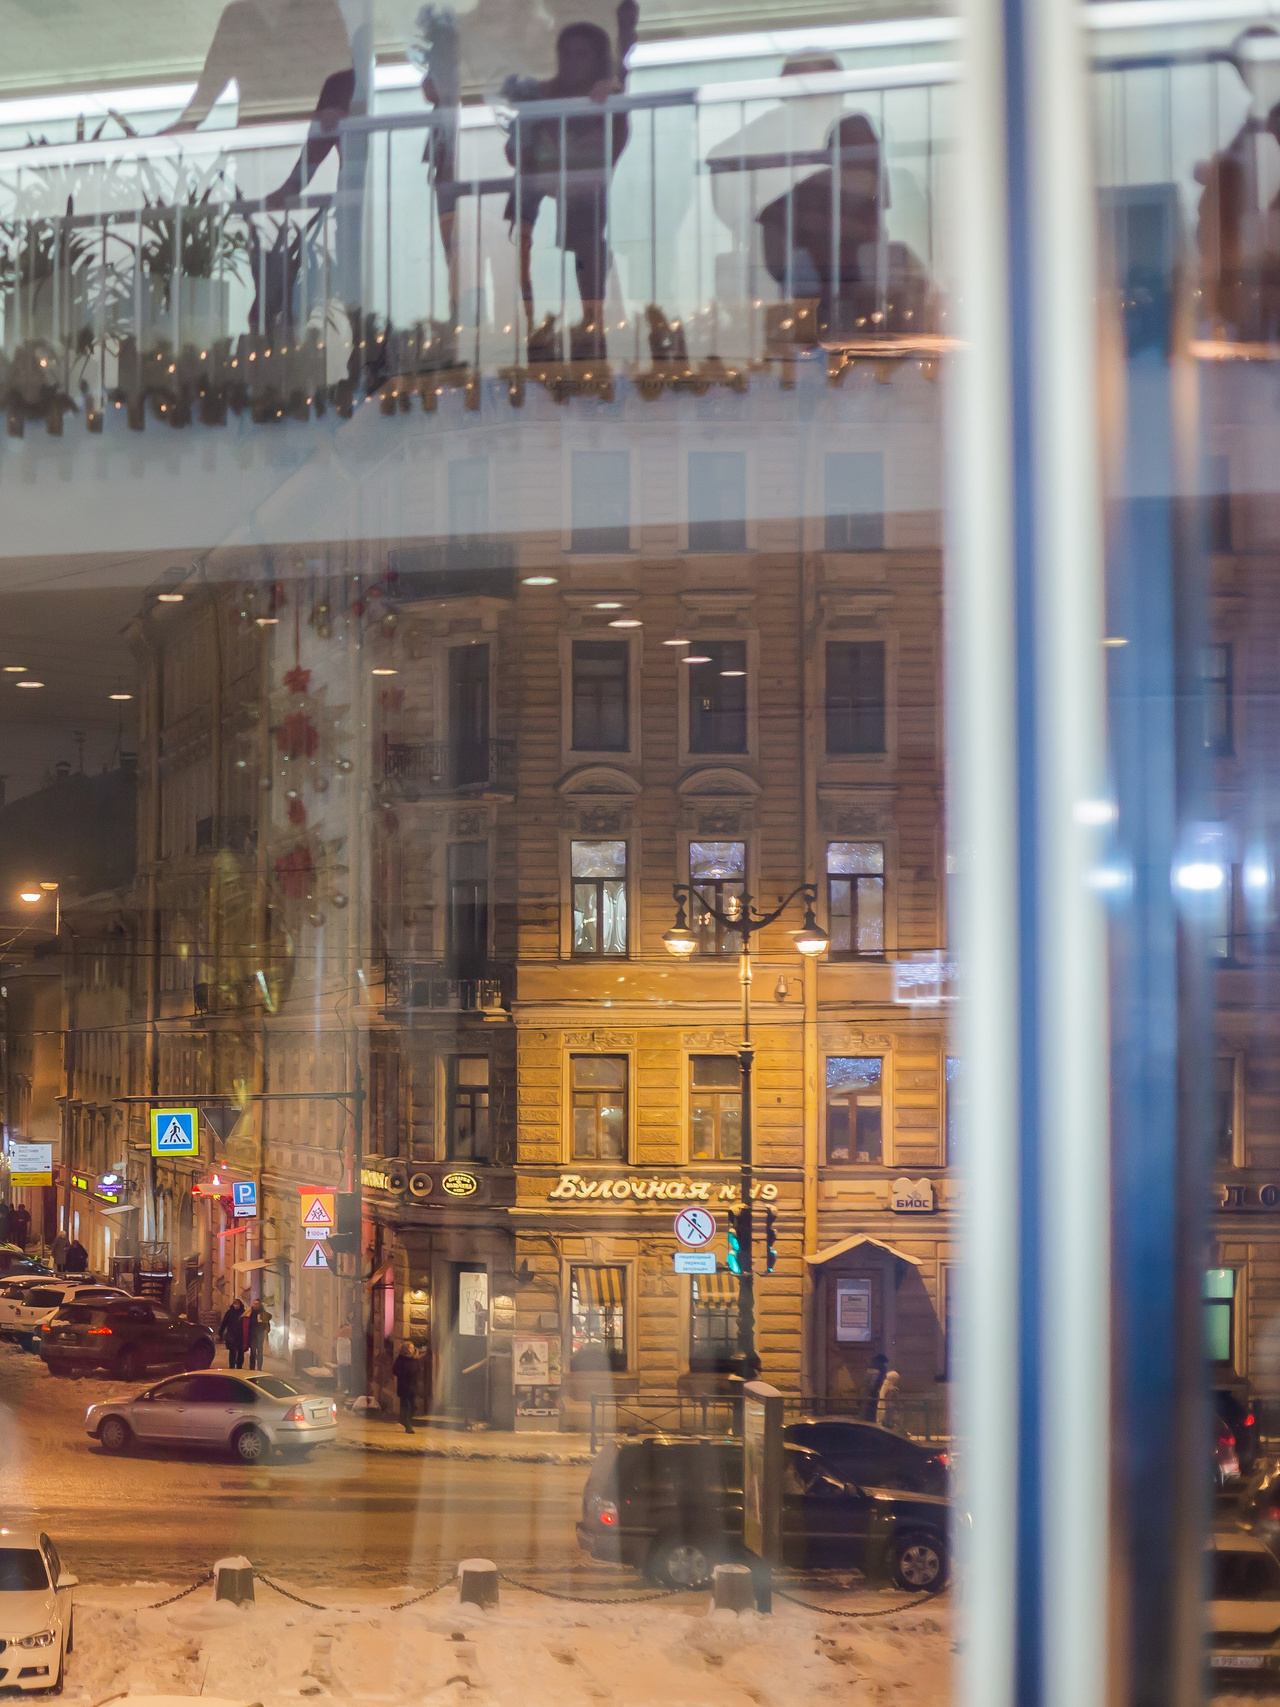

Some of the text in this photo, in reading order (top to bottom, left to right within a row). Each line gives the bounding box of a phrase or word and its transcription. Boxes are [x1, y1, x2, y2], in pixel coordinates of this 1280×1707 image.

[239, 1184, 252, 1203] P
[549, 1174, 713, 1200] Булочная
[896, 1199, 930, 1208] БИОС
